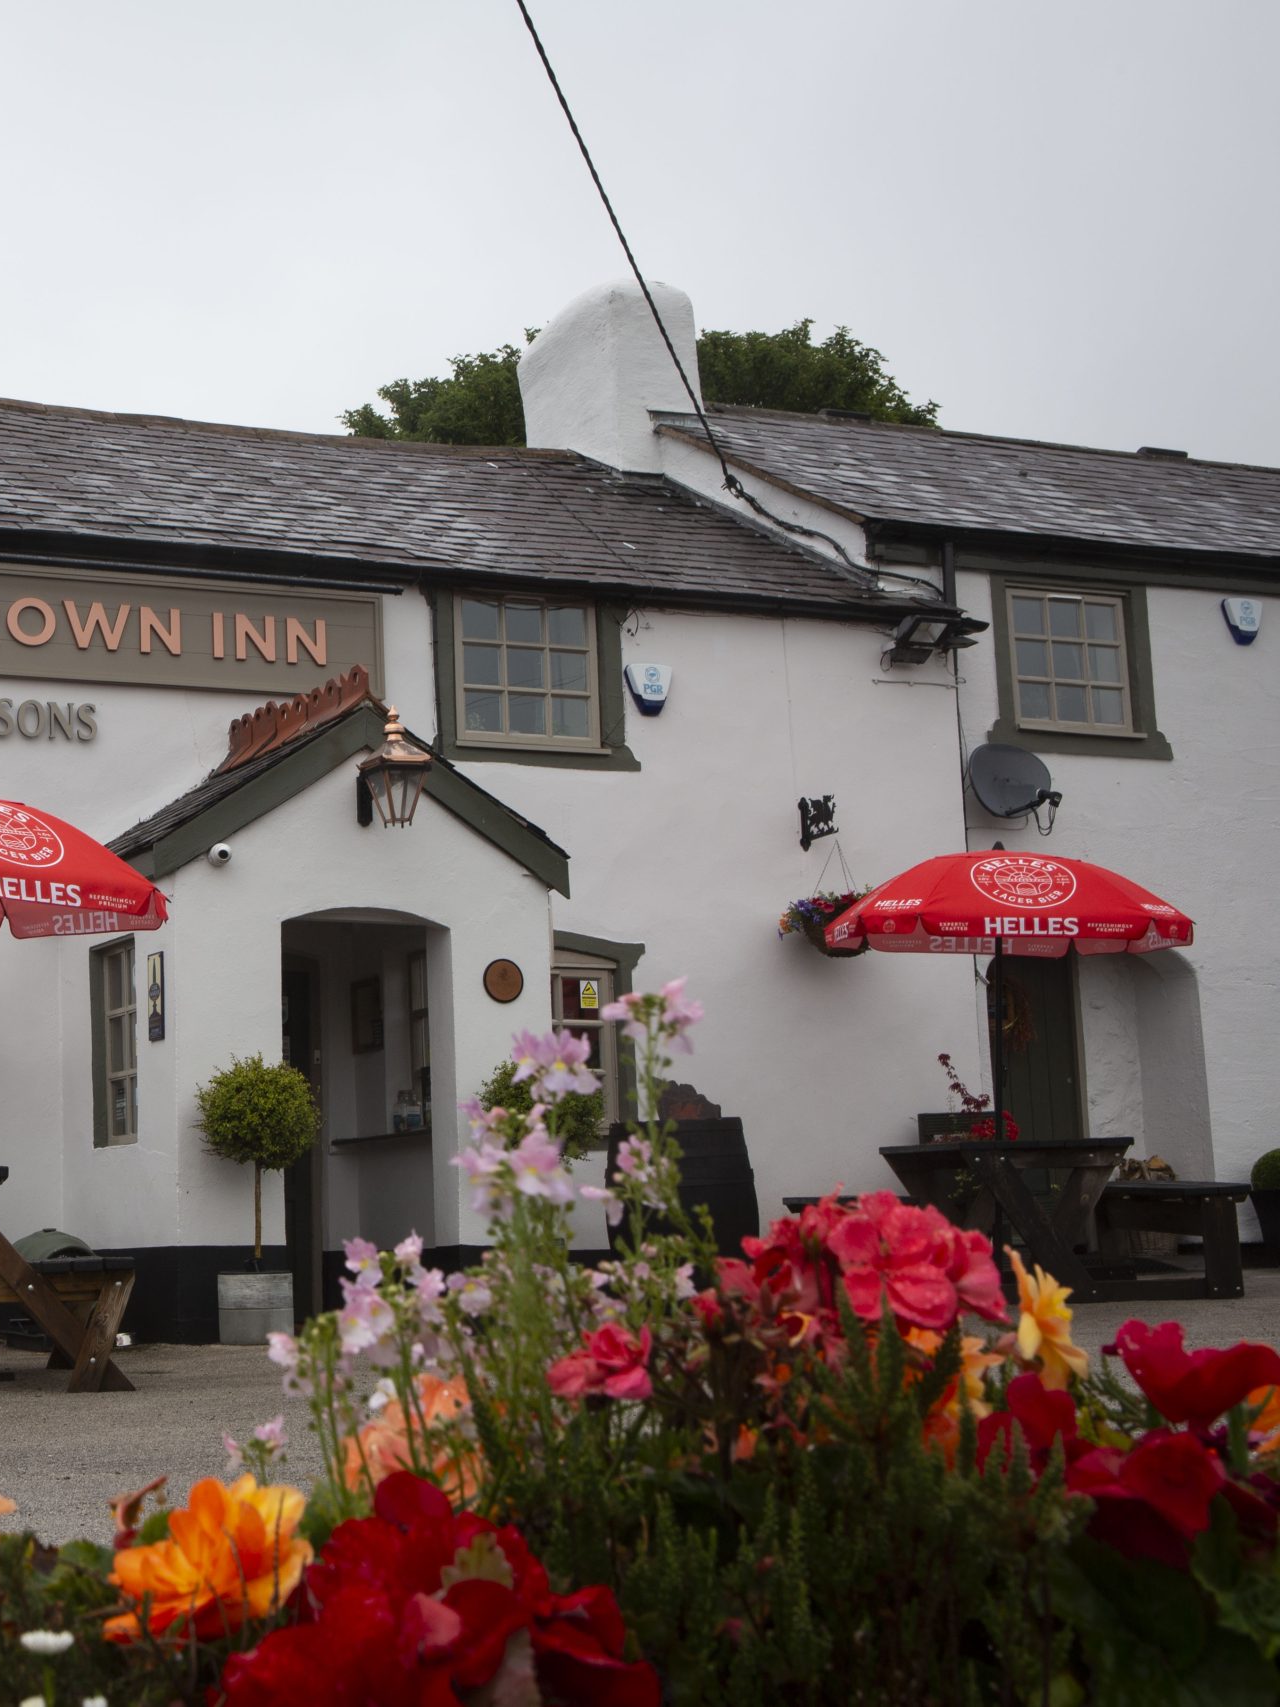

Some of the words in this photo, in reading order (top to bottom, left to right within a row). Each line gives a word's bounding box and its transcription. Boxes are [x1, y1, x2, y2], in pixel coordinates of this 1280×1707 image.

[212, 613, 327, 666] INN
[644, 684, 663, 693] PGR
[31, 847, 53, 861] BIER
[980, 859, 1058, 871] HELLES
[89, 894, 136, 905] REFRESHINGLY
[875, 899, 922, 907] HELLES
[993, 890, 1033, 904] LAGER
[1038, 890, 1063, 903] BIER
[98, 901, 128, 909] PREMIUM
[984, 916, 1079, 935] HELLES
